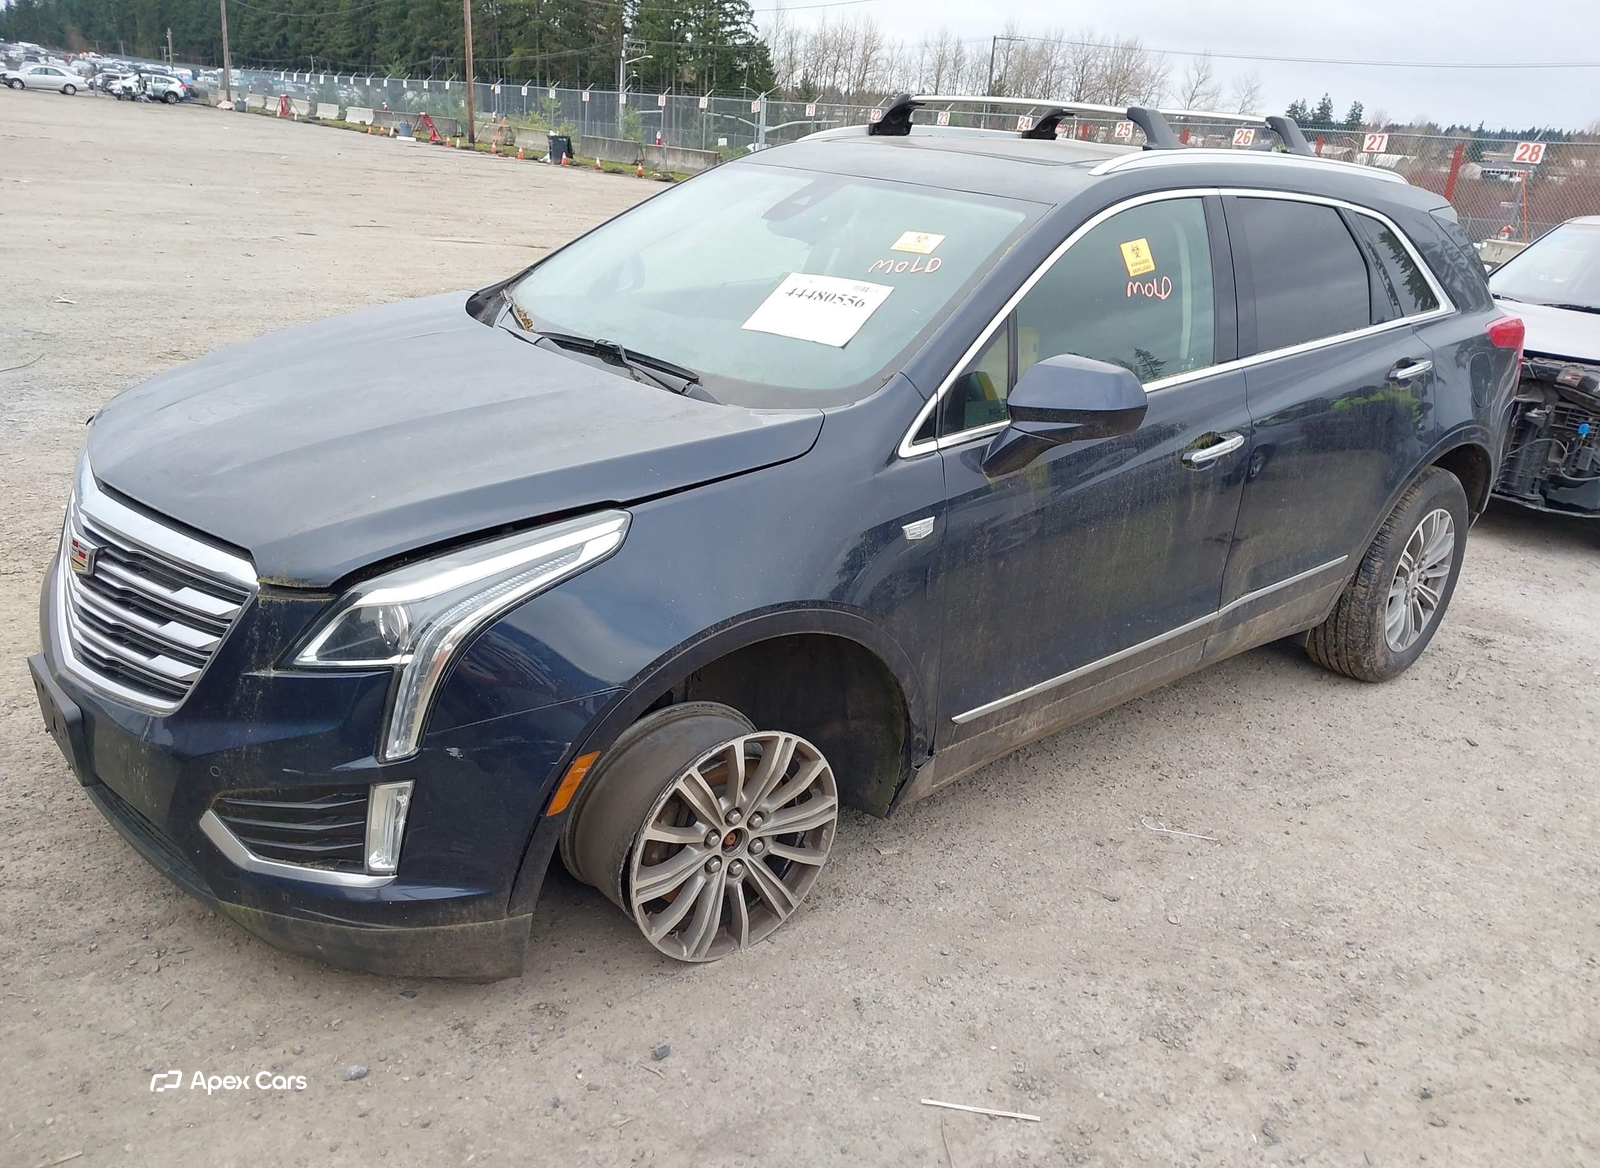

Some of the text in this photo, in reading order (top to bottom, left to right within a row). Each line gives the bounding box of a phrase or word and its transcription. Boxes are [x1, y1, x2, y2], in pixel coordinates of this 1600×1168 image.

[752, 101, 760, 112] 20
[807, 104, 815, 115] 21
[871, 109, 881, 120] 22
[939, 112, 949, 125] 23
[1018, 117, 1031, 130] 24
[1116, 123, 1132, 137] 25
[1234, 130, 1251, 145] 26
[1366, 134, 1385, 151] 27
[1516, 143, 1542, 162] 28
[1126, 275, 1172, 300] MOLD
[785, 287, 865, 308] 44480556
